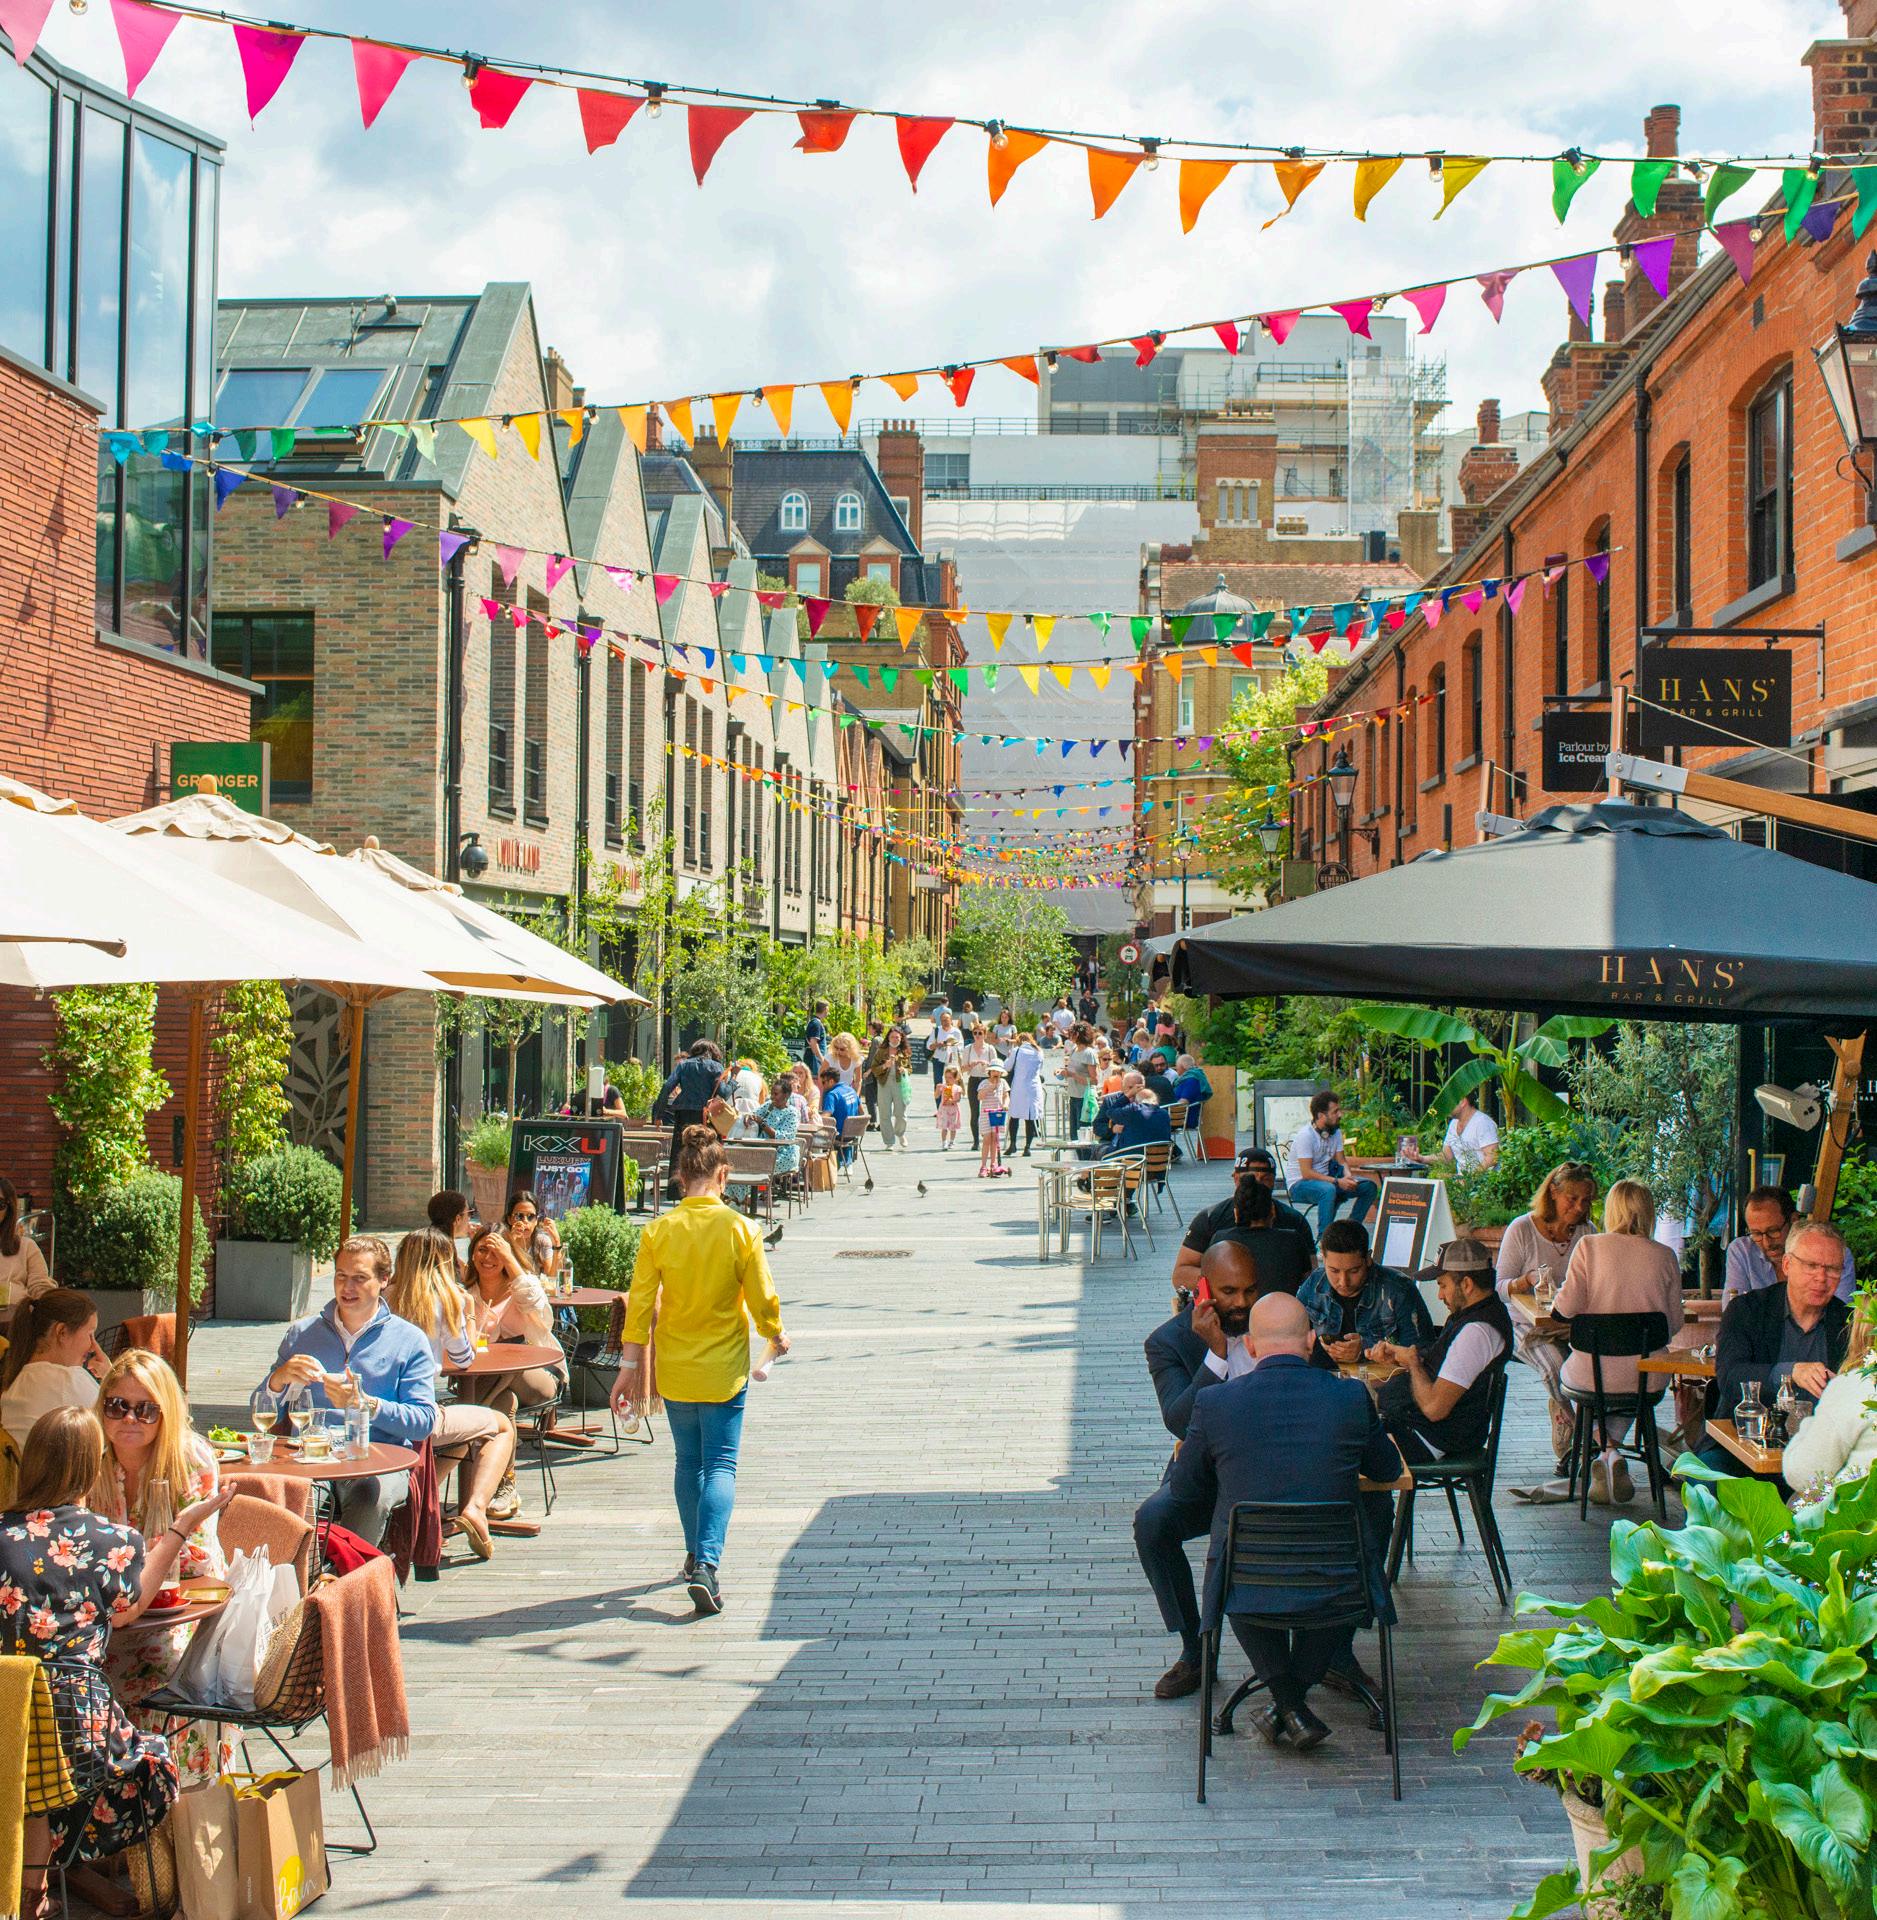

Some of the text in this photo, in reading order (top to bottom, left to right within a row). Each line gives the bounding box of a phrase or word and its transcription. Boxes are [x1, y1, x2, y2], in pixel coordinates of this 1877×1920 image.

[1659, 678, 1776, 703] HANS'
[1706, 708, 1713, 717] &
[1721, 708, 1764, 717] GRILL
[1559, 742, 1610, 754] Parlour by
[1559, 753, 1575, 763] Ice
[177, 774, 258, 788] GRNGER
[1598, 955, 1745, 990] HANS'
[1611, 992, 1724, 1006] BAR & GRILL
[523, 1134, 608, 1155] KXU
[536, 1165, 564, 1173] JUST
